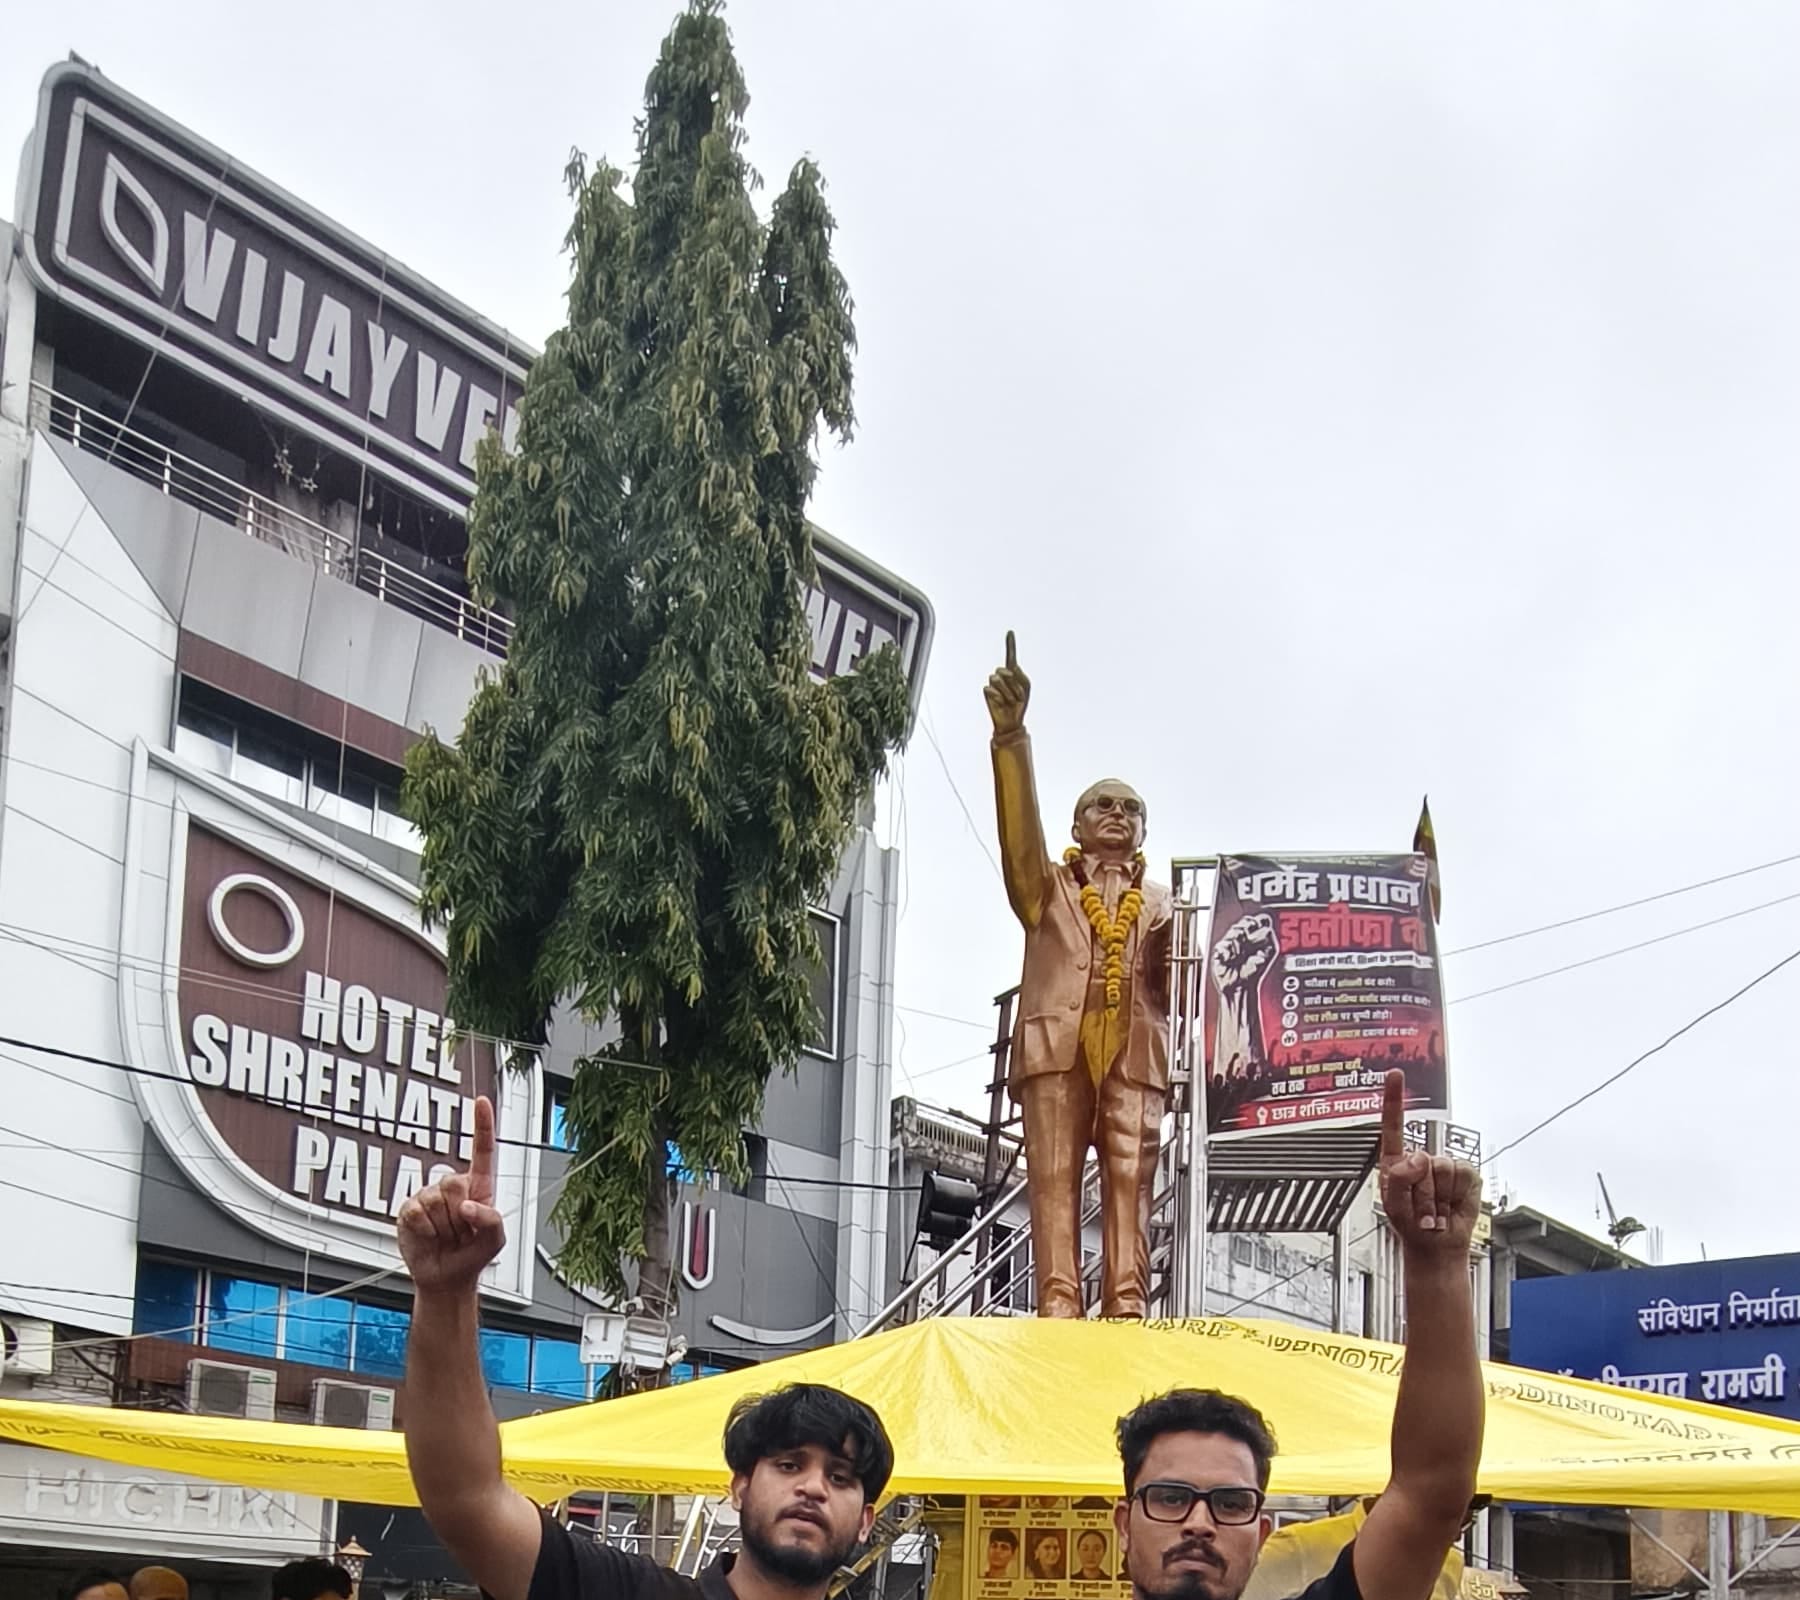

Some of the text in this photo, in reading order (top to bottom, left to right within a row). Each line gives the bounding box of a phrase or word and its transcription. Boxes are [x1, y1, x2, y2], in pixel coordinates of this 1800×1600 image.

[1327, 873, 1421, 907] प्रधान
[302, 970, 462, 1084] HOTEL
[1271, 1093, 1384, 1121] छात्र शक्ति मध्यप्रदे
[294, 1125, 457, 1218] PALA
[1638, 1298, 1721, 1332] संविधान
[1701, 1353, 1787, 1400] रामजी
[25, 1468, 297, 1534] HICHKI
